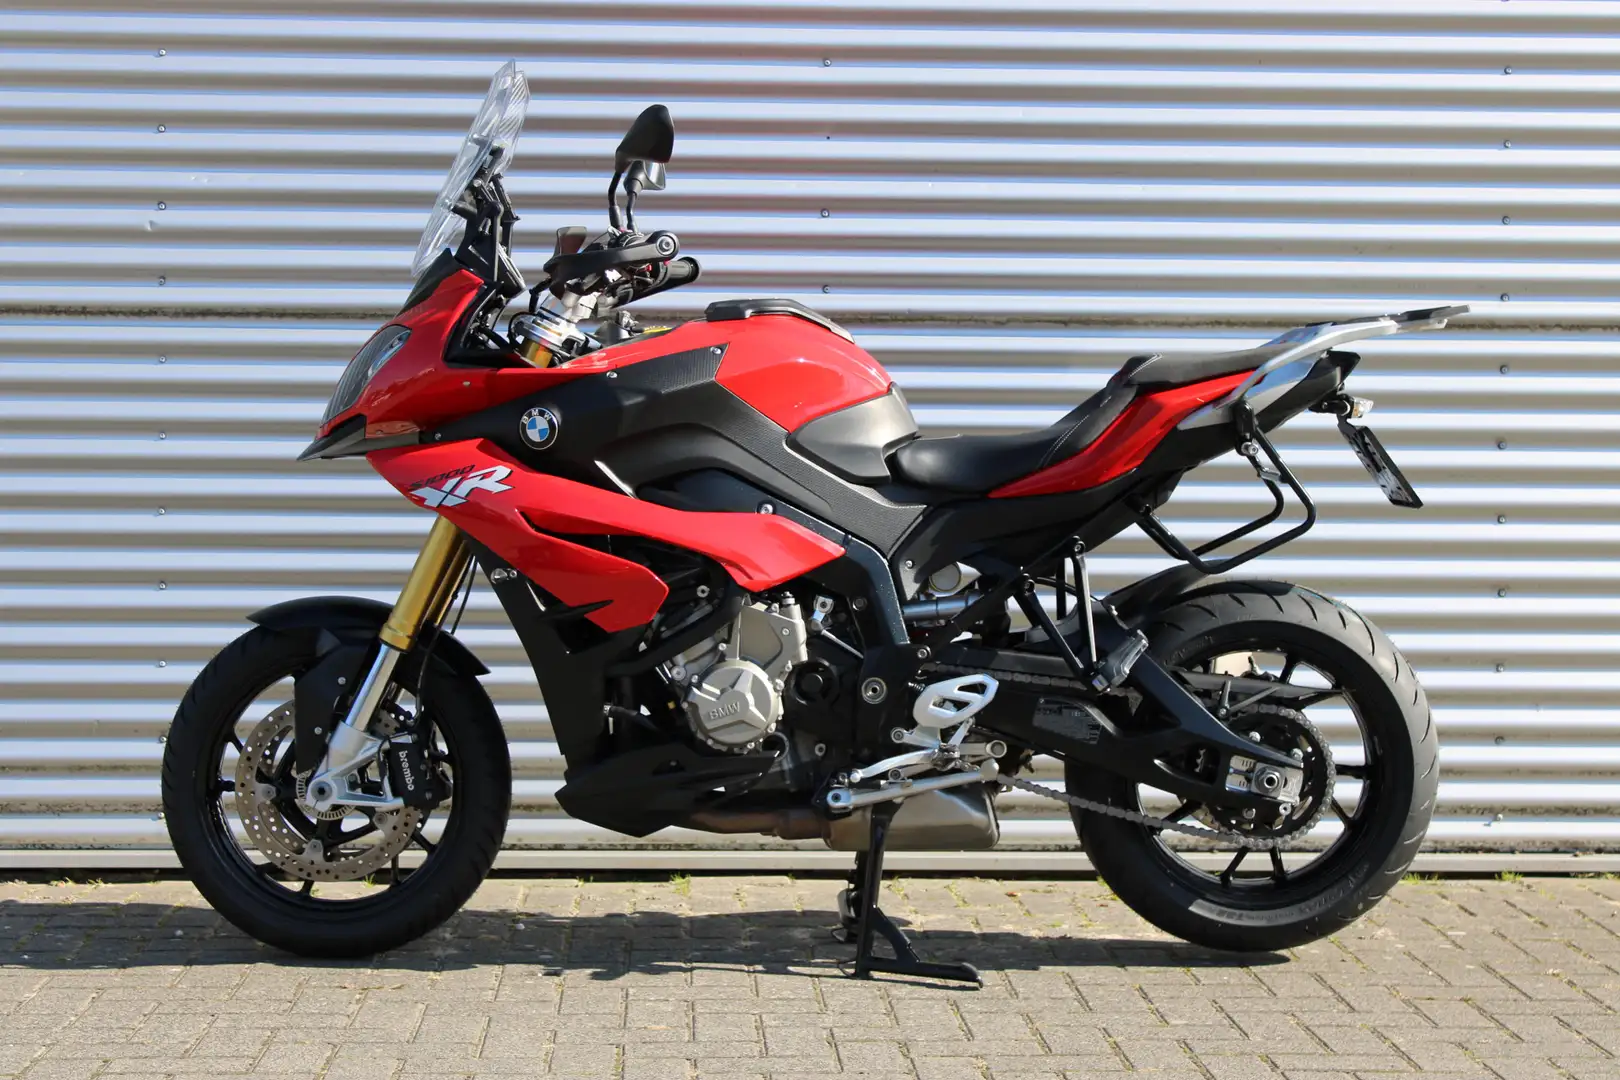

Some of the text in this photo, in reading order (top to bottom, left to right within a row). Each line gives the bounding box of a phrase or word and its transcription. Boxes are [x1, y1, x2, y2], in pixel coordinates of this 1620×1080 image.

[521, 409, 552, 425] BMW
[409, 465, 515, 508] XR
[709, 702, 740, 719] BMW
[399, 750, 414, 791] brembo
